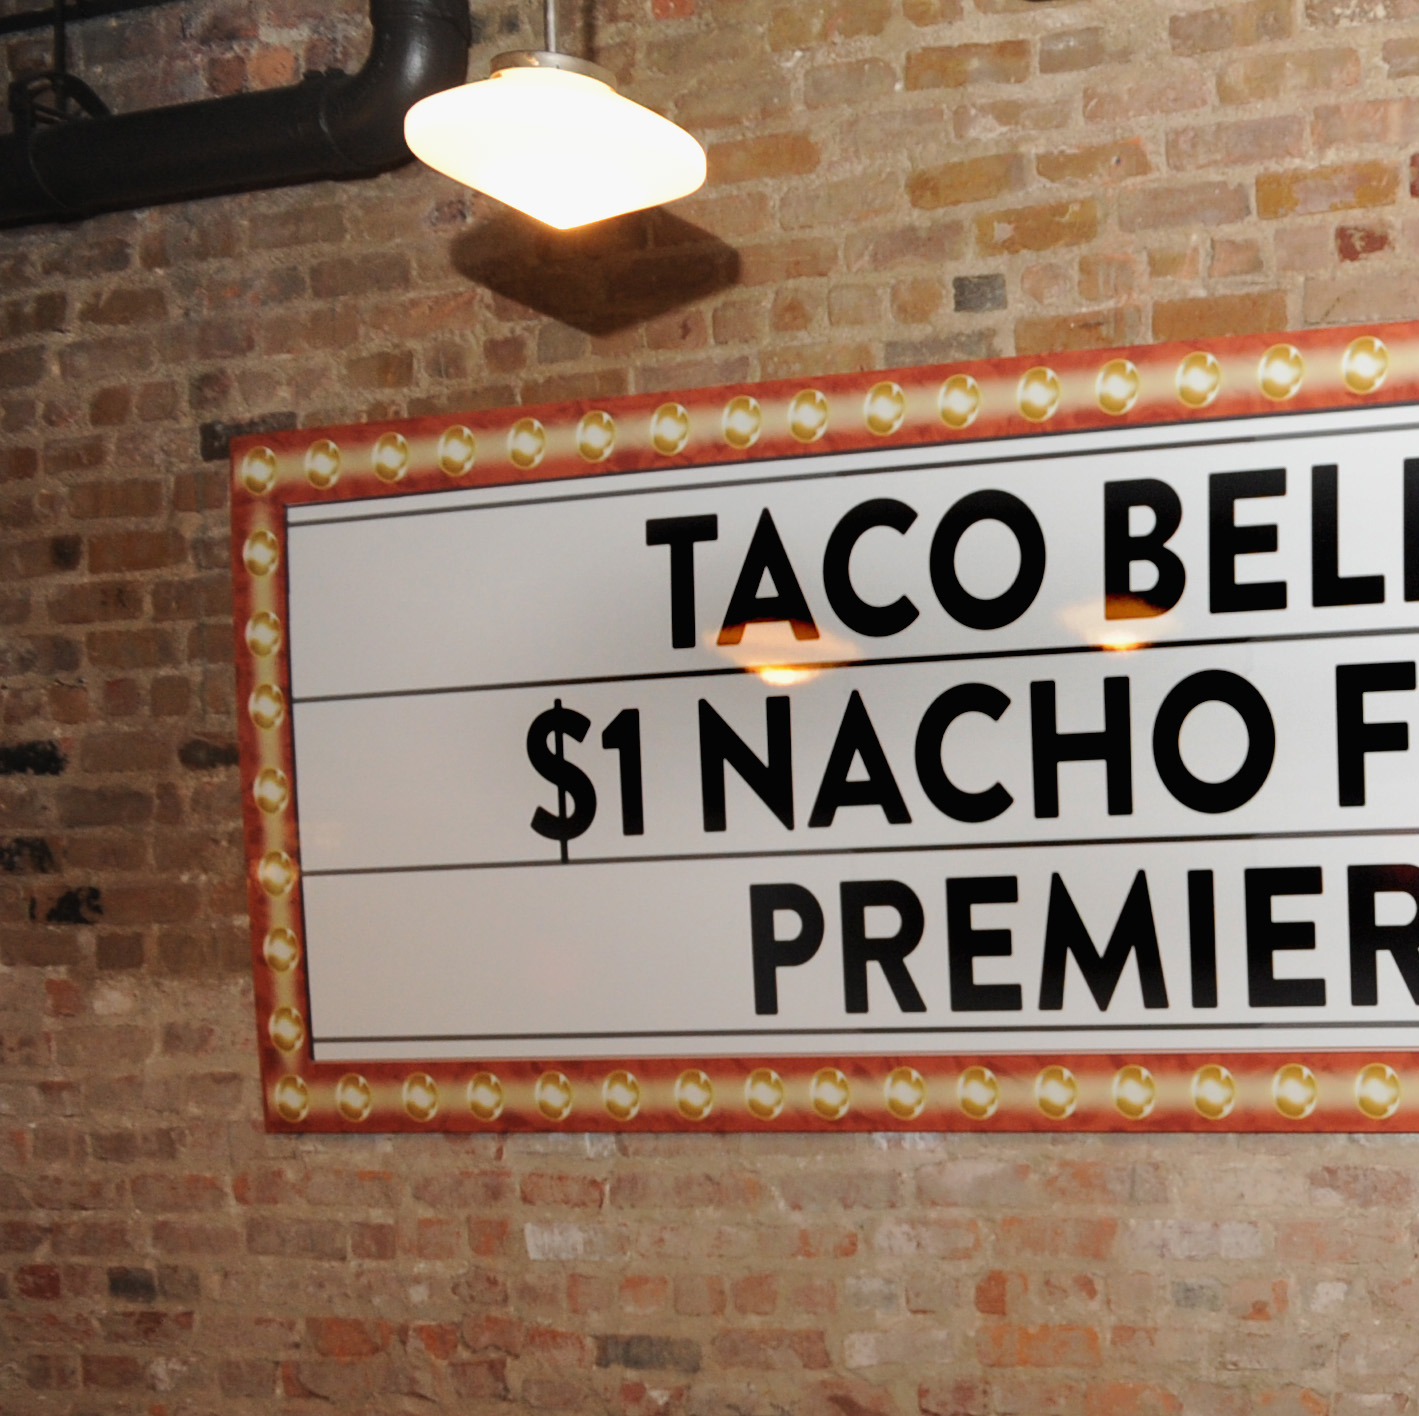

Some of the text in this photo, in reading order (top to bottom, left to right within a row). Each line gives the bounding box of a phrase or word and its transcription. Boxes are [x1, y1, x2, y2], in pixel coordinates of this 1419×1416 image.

[645, 488, 1047, 650] TACO
[526, 698, 645, 866] $1
[697, 668, 1276, 833] NACHO
